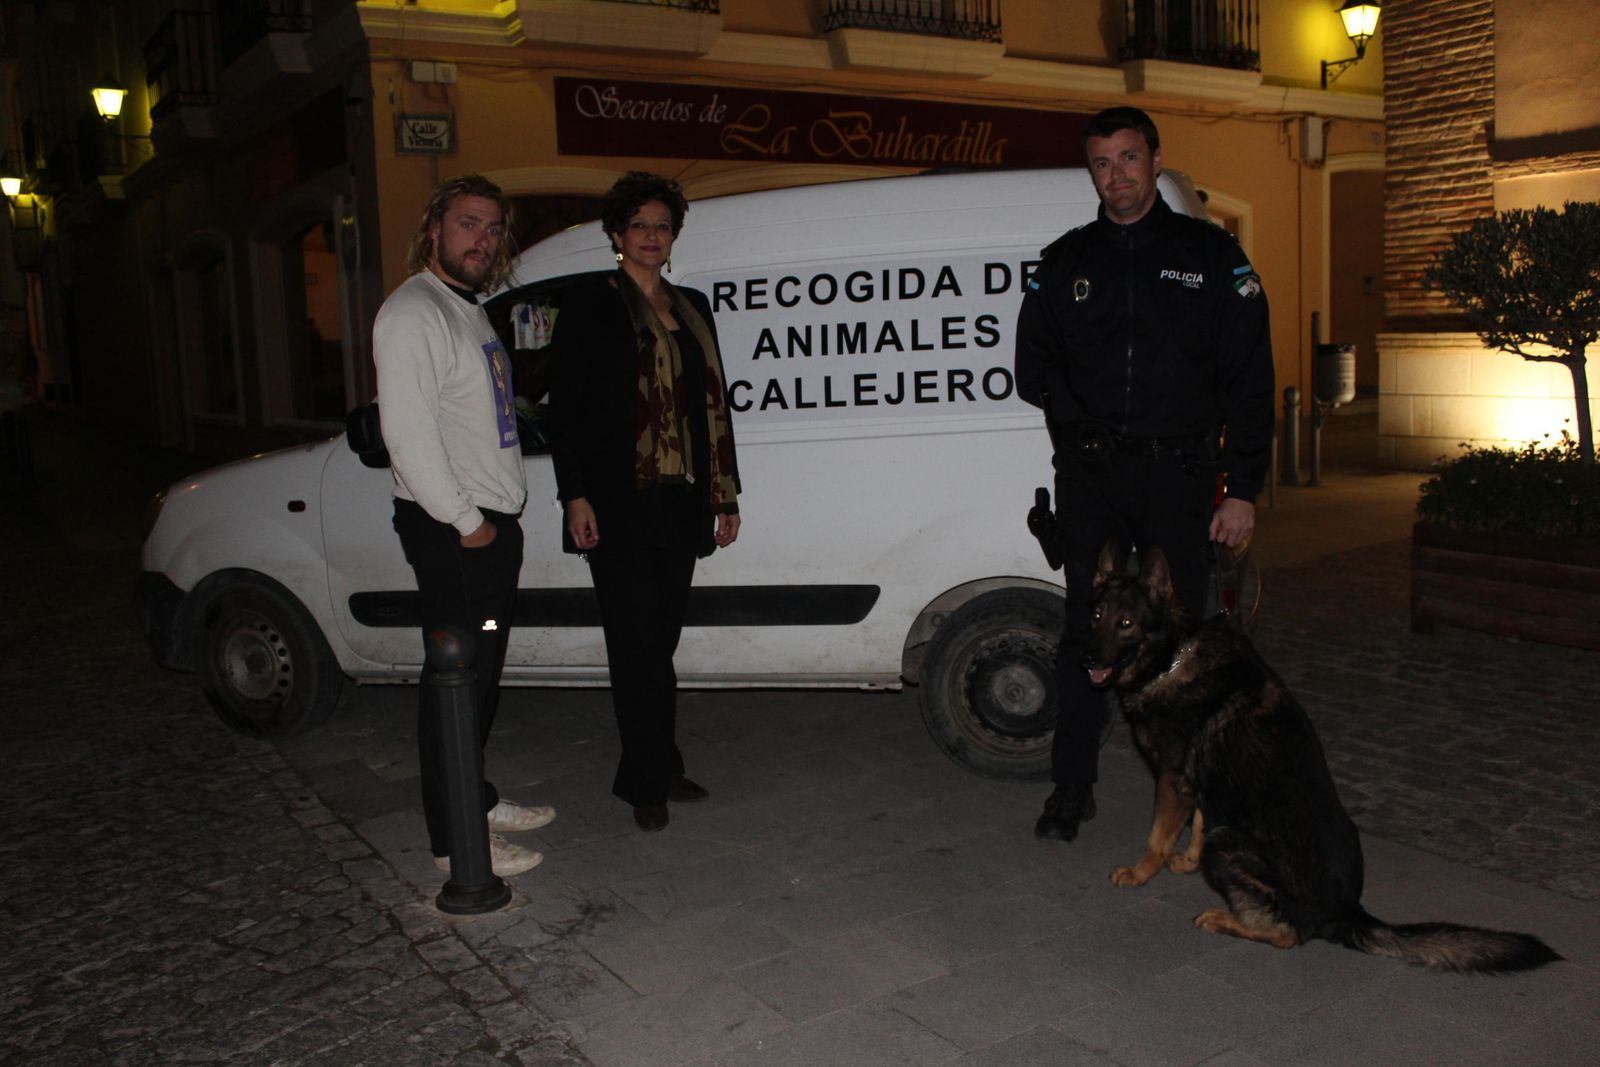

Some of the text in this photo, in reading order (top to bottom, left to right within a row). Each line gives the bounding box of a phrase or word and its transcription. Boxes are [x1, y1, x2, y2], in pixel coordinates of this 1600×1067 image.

[574, 84, 728, 123] Secretos de
[412, 122, 437, 134] Calle
[720, 103, 1008, 165] La Buhardilla
[713, 265, 962, 311] RECOGIDA
[1160, 270, 1203, 283] POLICIA
[753, 315, 1000, 359] ANIMALES
